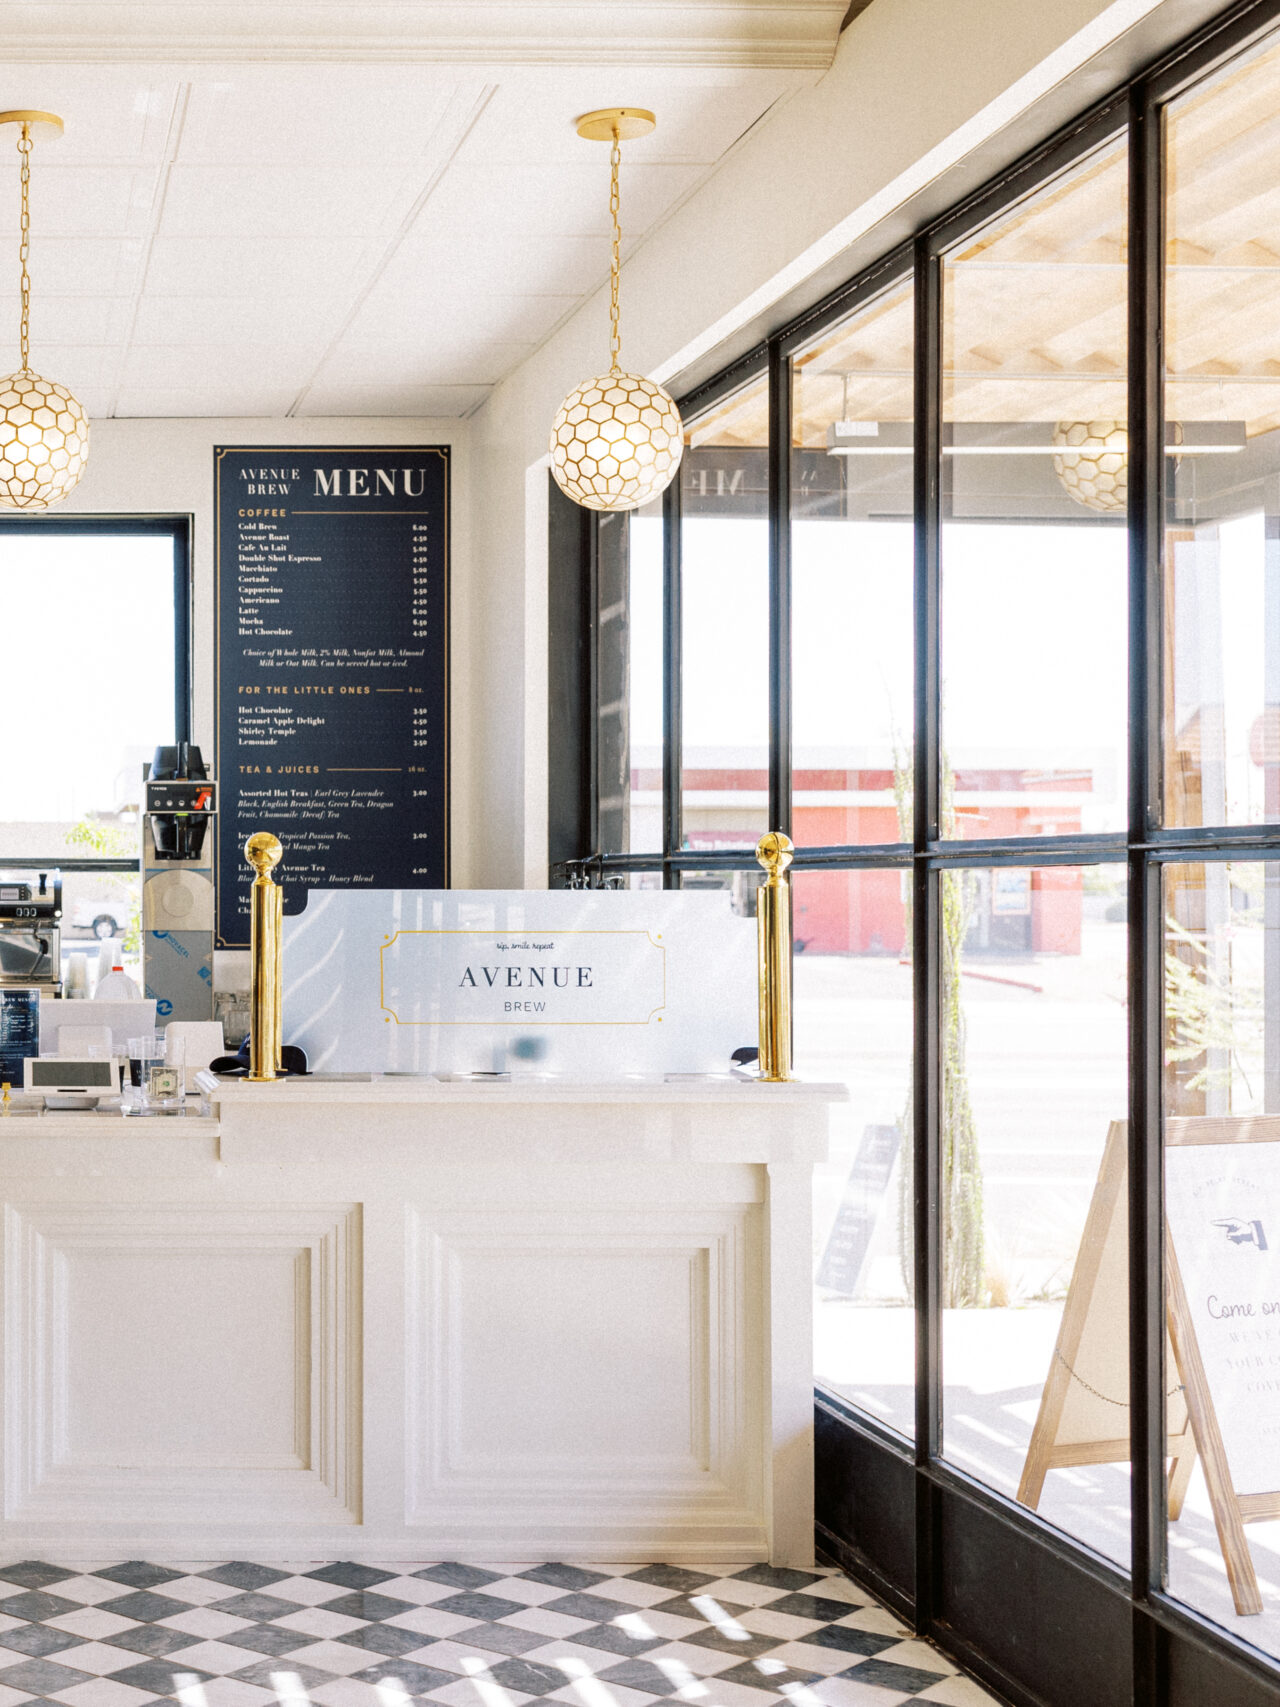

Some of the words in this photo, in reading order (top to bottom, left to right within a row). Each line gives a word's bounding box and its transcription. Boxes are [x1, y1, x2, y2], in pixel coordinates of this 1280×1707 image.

[239, 469, 300, 480] AVENUE
[313, 469, 426, 496] MENU
[248, 484, 291, 495] BREW
[238, 508, 286, 517] COFFEE
[288, 554, 322, 563] Espresso
[238, 586, 283, 595] Cappuccino
[267, 648, 276, 658] of
[354, 648, 376, 658] Nonfat
[238, 686, 260, 694] FOR
[266, 686, 288, 694] THE
[294, 686, 334, 694] LITTLE
[340, 686, 370, 694] ONES
[273, 717, 294, 726] Apple
[297, 717, 325, 726] Delight
[238, 727, 265, 736] Shirley
[268, 727, 296, 736] Temple
[239, 766, 260, 774] TEA
[266, 766, 272, 774] &
[278, 766, 319, 774] JUICES
[332, 789, 349, 798] Grey
[261, 800, 288, 809] English
[290, 800, 326, 809] Breakfast,
[367, 800, 394, 810] Dragon
[278, 832, 307, 841] Tropical
[293, 843, 316, 852] Mango
[298, 875, 320, 884] Syrup
[329, 874, 351, 884] Honey
[532, 942, 554, 952] repeat
[458, 966, 594, 988] AVENUE
[504, 1001, 547, 1012] BREW
[1207, 1295, 1256, 1320] Come
